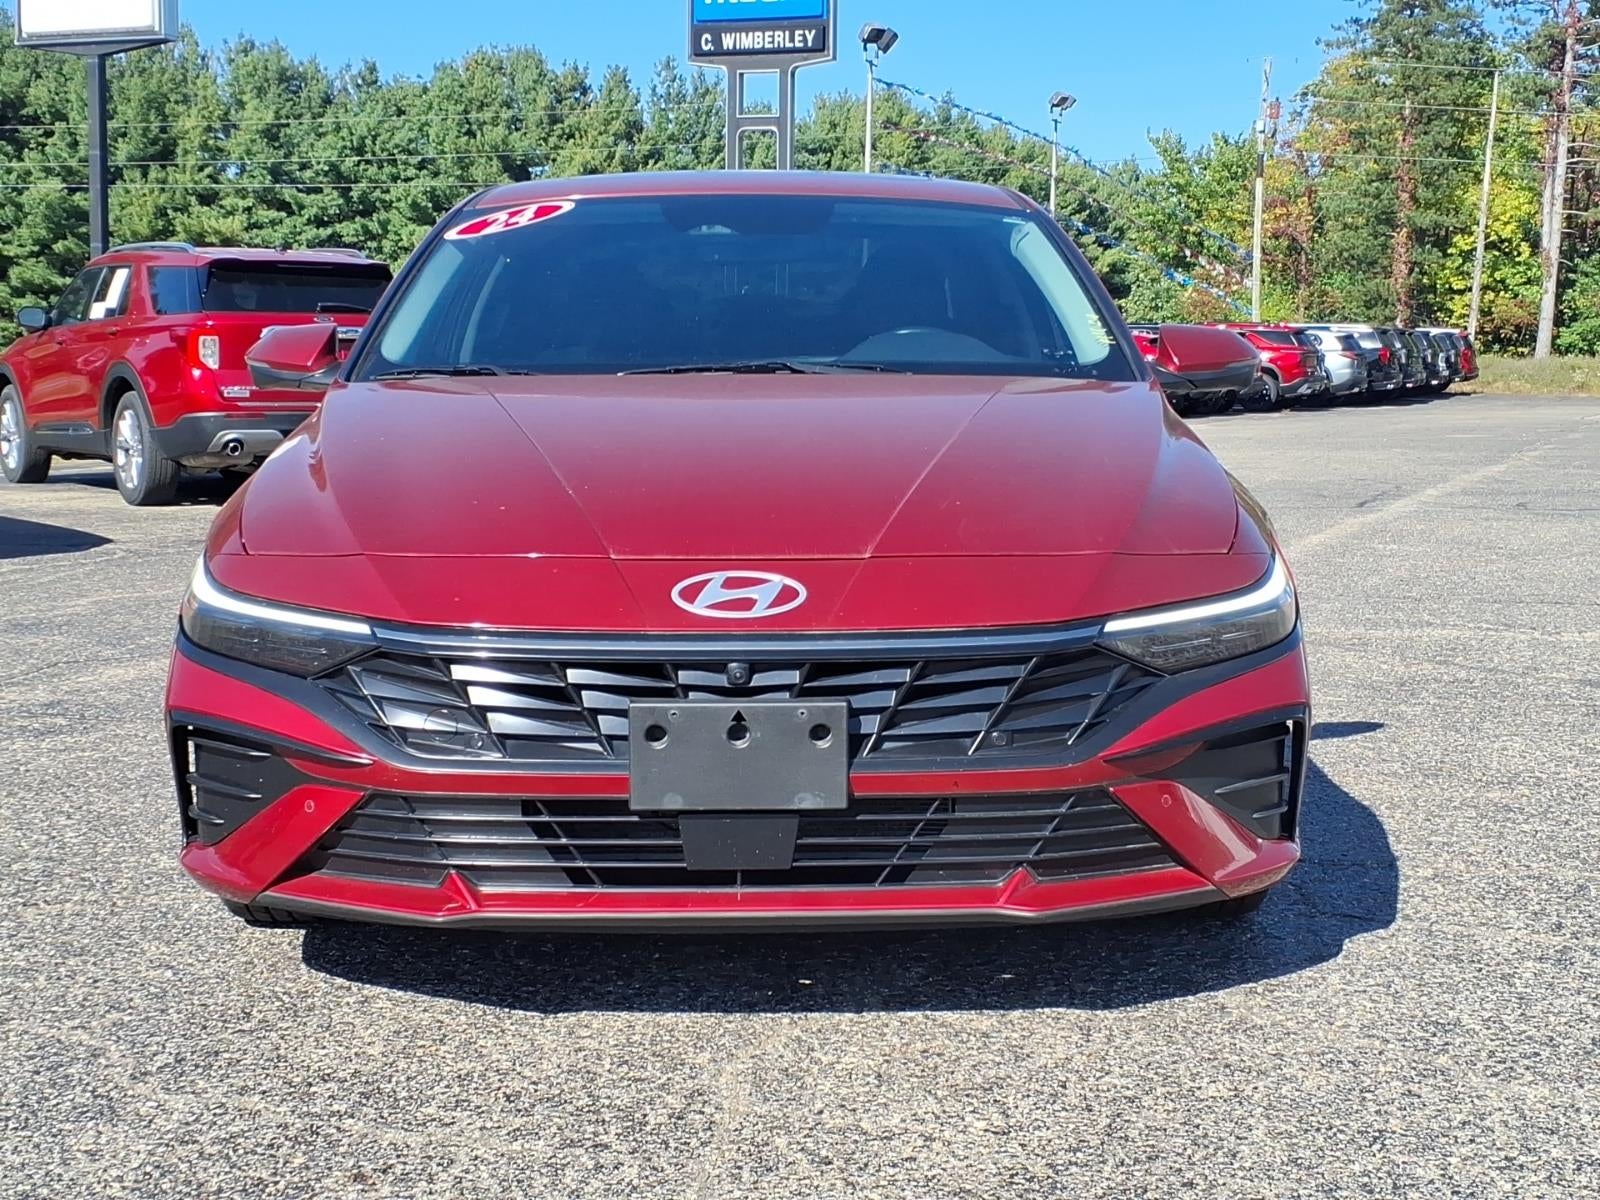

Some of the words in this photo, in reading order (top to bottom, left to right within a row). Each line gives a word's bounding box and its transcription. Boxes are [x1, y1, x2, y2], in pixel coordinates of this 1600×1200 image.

[701, 33, 714, 50] C.
[721, 29, 815, 49] WIMBERLEY
[480, 205, 538, 232] 24
